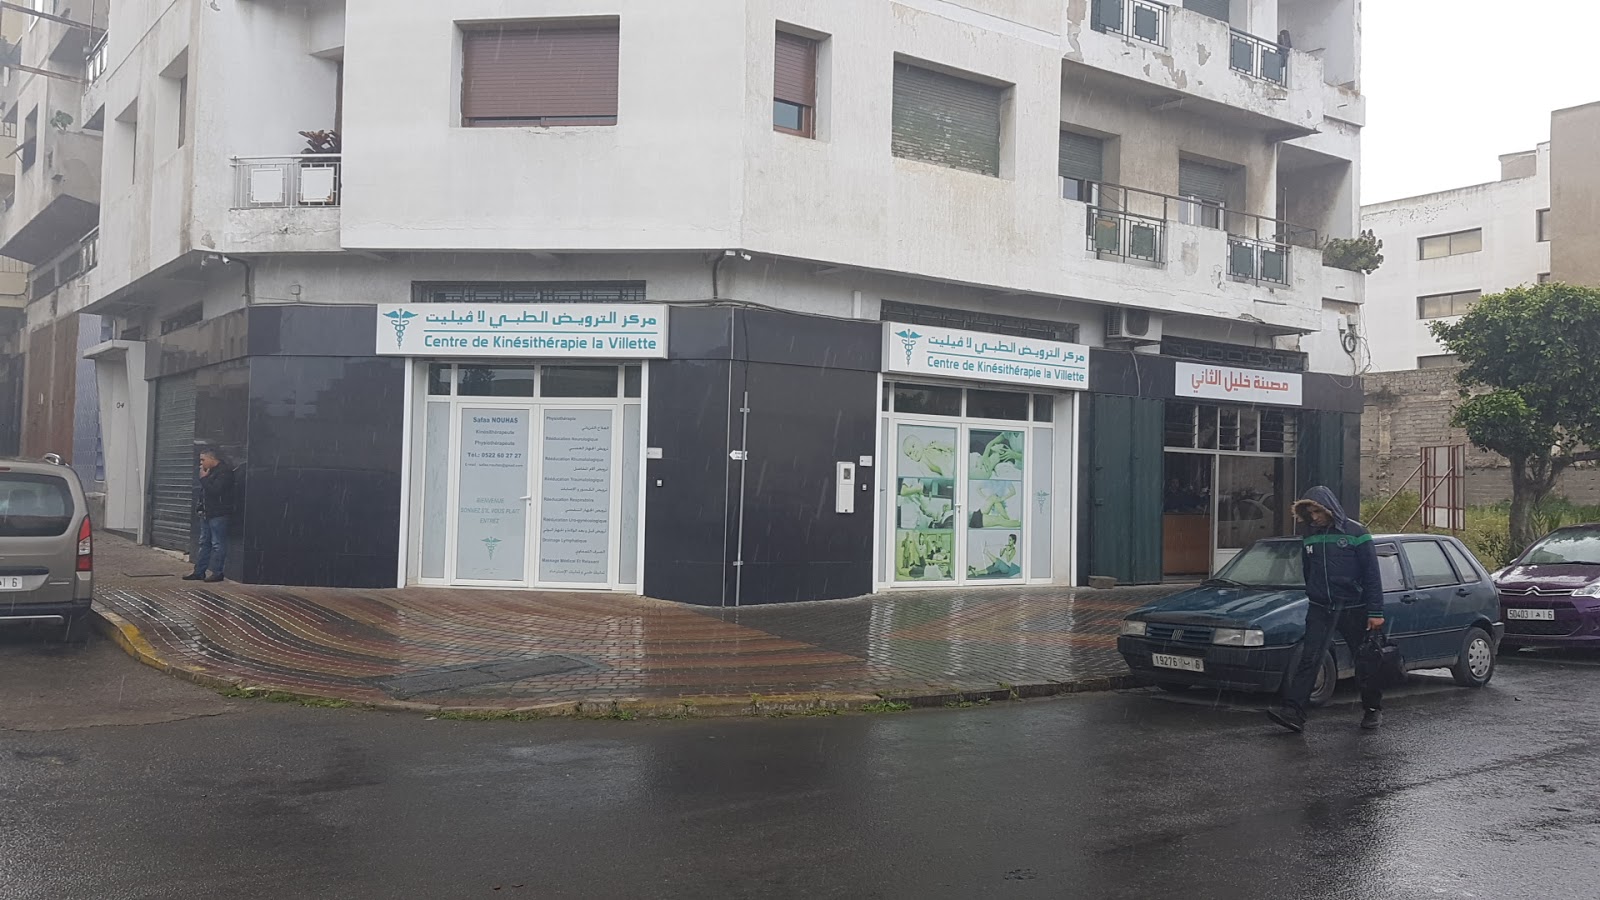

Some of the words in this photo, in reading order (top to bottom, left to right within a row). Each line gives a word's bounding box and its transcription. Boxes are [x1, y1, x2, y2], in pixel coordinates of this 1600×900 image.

[477, 310, 485, 323] لا
[489, 310, 548, 329] الطبي
[552, 311, 617, 328] الترويض
[621, 312, 657, 328] مركز
[424, 335, 468, 348] Centre
[471, 335, 489, 348] de
[493, 335, 588, 352] Kinésithérapie
[592, 336, 604, 349] la
[608, 336, 657, 350] Villette
[966, 337, 972, 348] لا
[974, 341, 1015, 355] الطبي
[1018, 345, 1060, 360] الترويض
[1062, 349, 1085, 363] مركز
[927, 355, 960, 370] Centre
[962, 359, 975, 371] de
[977, 361, 1041, 380] Kinésithérapie
[1044, 367, 1051, 378] la
[1054, 369, 1085, 382] Villette
[1191, 368, 1222, 393] الثاني
[1224, 371, 1251, 392] خليل
[1253, 375, 1289, 394] مصبنة
[12, 577, 18, 588] 6
[1509, 609, 1529, 619] 50403
[1547, 610, 1553, 619] 6
[1155, 655, 1178, 667] 19276
[1195, 659, 1201, 670] 6
